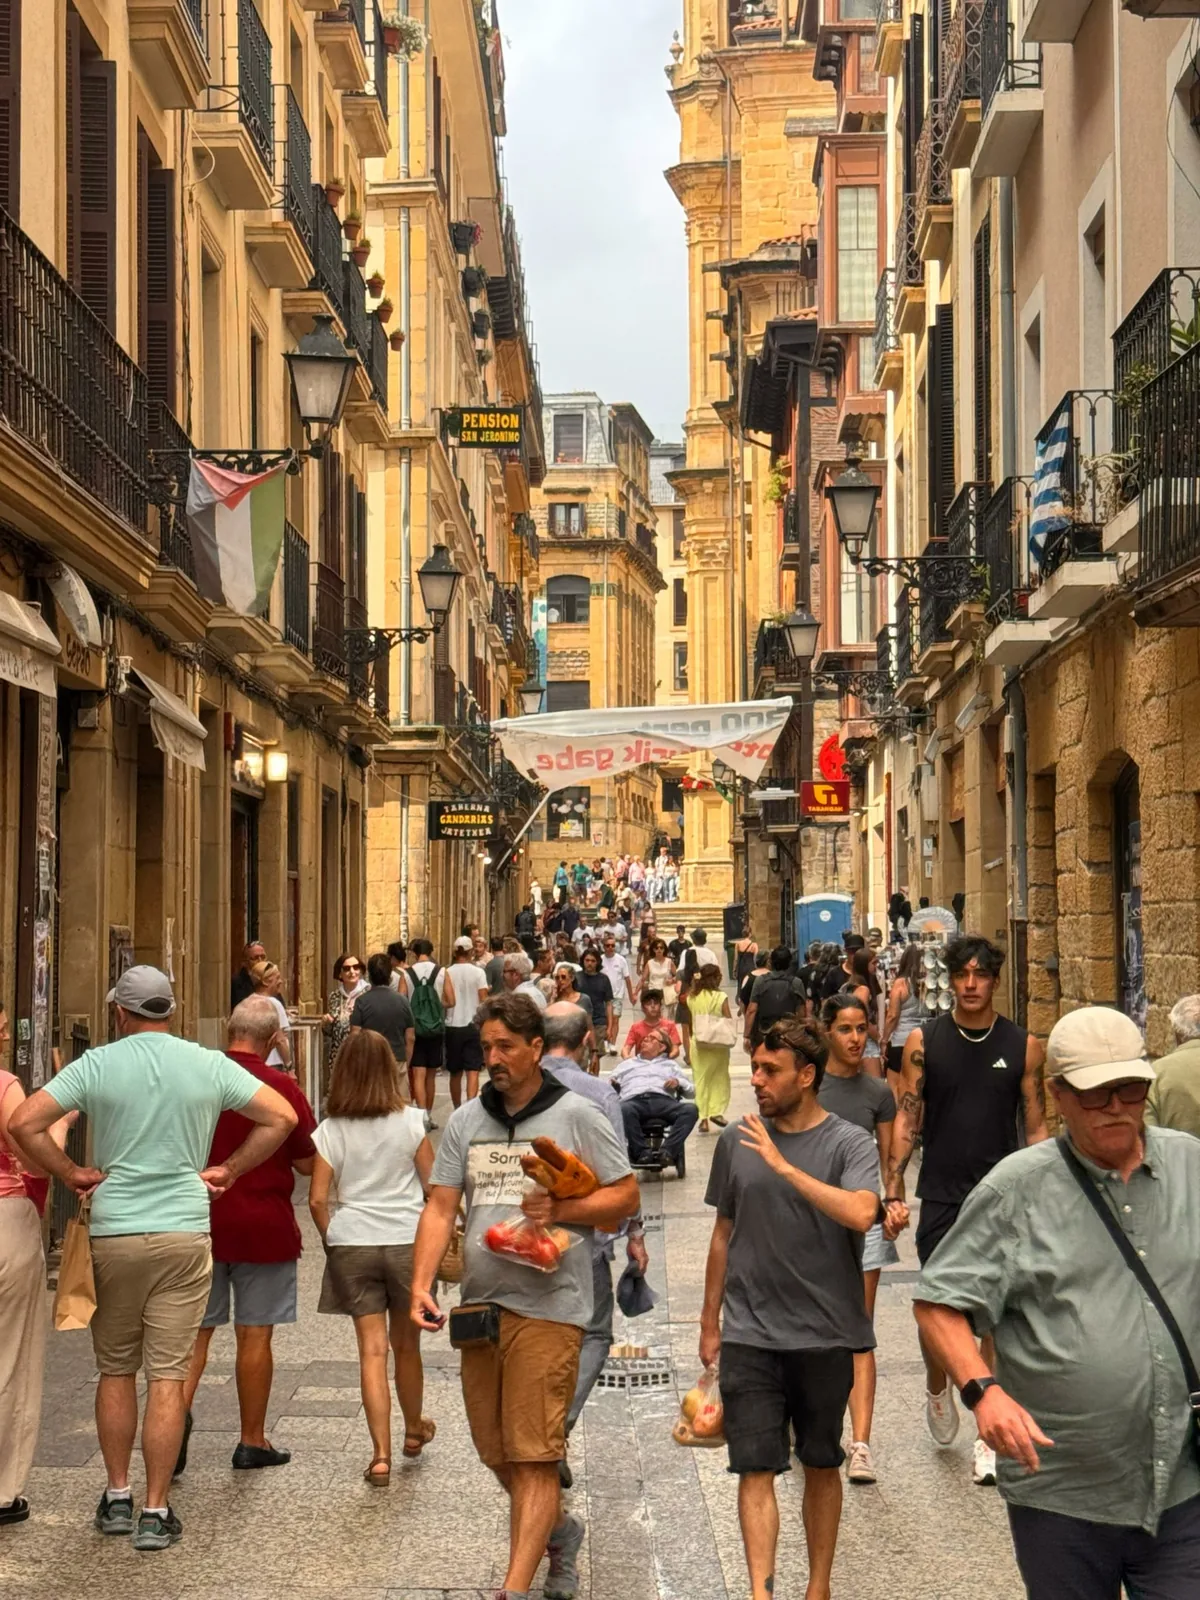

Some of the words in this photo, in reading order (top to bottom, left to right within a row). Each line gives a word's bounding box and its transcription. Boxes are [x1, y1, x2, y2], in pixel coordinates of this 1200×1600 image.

[463, 413, 519, 428] PENSION
[461, 431, 477, 442] SAN
[480, 431, 520, 443] JERONIMO
[440, 814, 494, 824] GANDARIAS
[441, 827, 492, 837] JATETXEA
